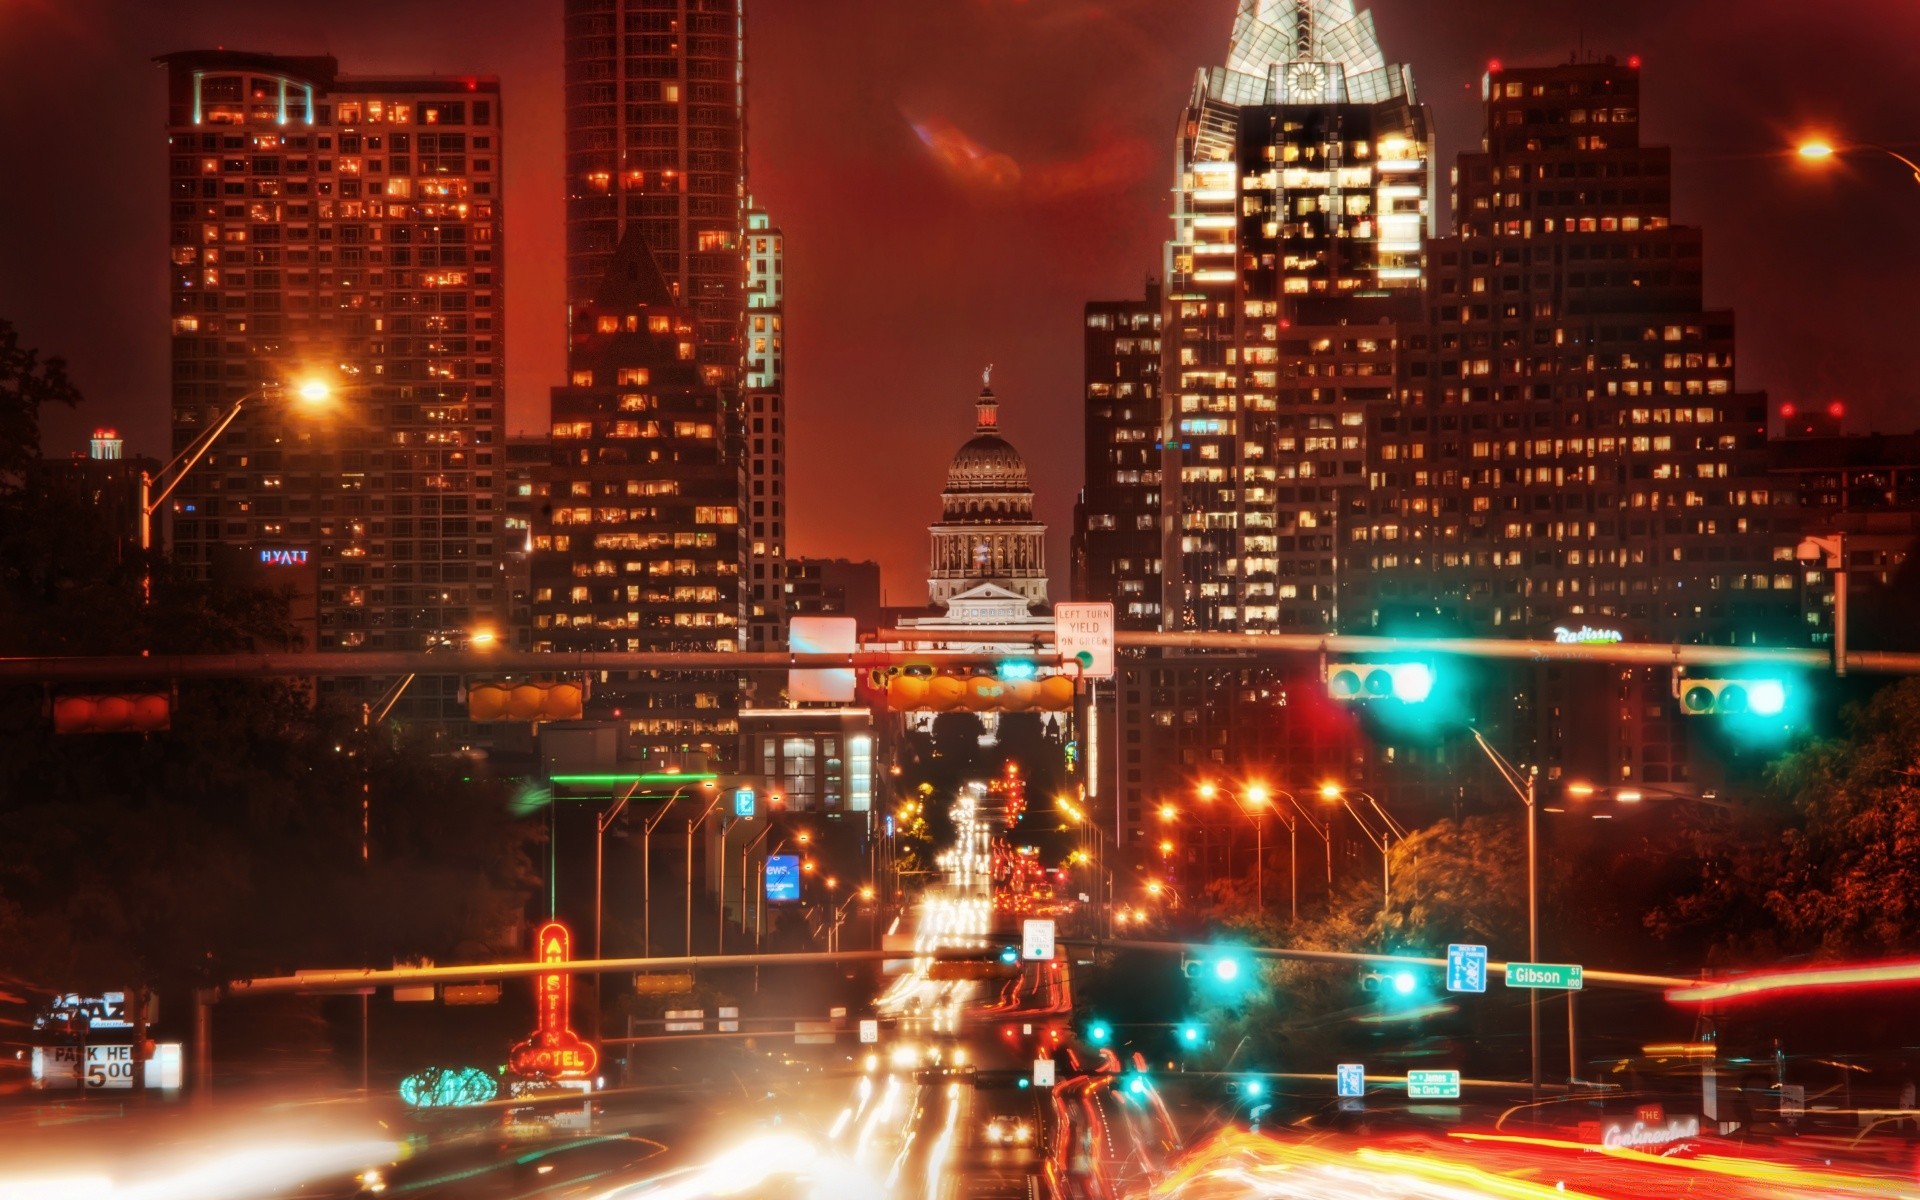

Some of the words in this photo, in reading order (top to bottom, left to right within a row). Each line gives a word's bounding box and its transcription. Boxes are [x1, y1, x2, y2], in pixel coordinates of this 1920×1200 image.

[260, 550, 309, 565] HYATT
[1060, 610, 1080, 619] LEFT
[1086, 610, 1109, 619] TURN
[1070, 622, 1099, 633] YIELD
[1553, 625, 1623, 643] Radisson
[1079, 637, 1107, 645] GREEN
[1516, 967, 1561, 984] Gibson
[1571, 967, 1580, 976] ST
[1568, 978, 1580, 987] 100
[55, 1047, 97, 1062] PAK
[519, 1050, 585, 1067] MOTEL
[1640, 1110, 1659, 1120] THE
[1603, 1118, 1698, 1150] Continental
